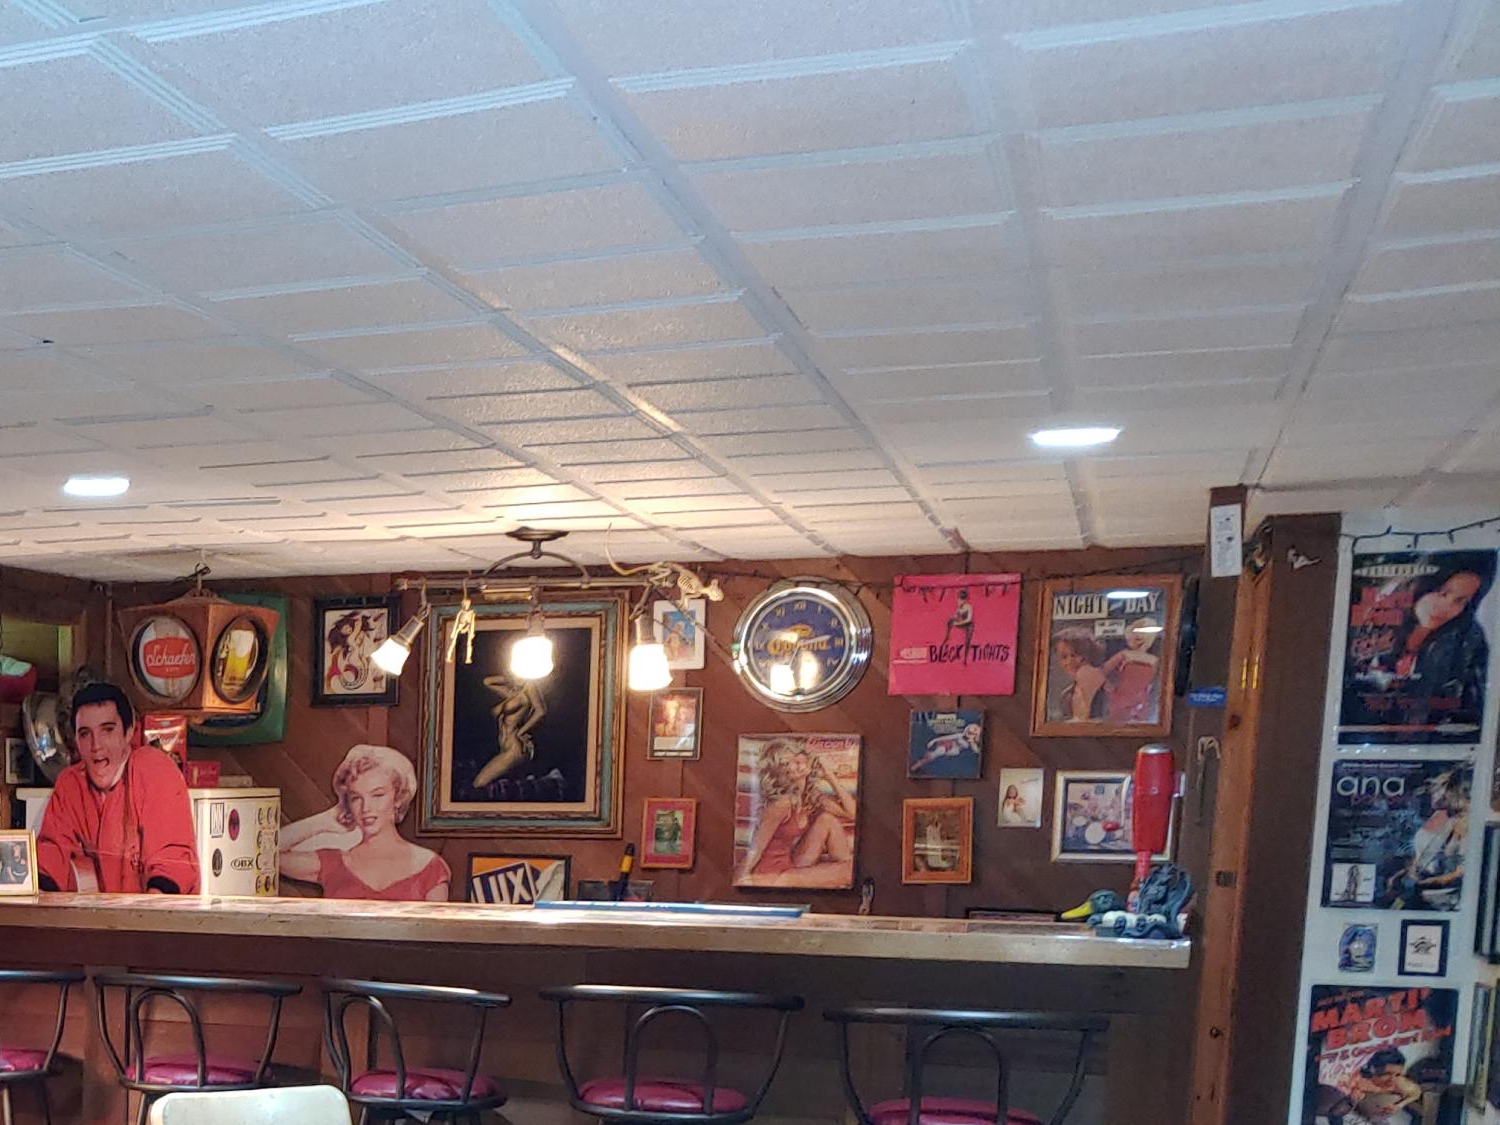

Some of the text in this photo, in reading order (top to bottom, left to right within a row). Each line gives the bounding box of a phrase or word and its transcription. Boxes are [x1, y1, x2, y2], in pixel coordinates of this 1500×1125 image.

[1055, 592, 1161, 615] NIGHT DAY
[970, 642, 1011, 662] TIGHTS
[1336, 775, 1405, 797] ana
[472, 866, 533, 904] LUX
